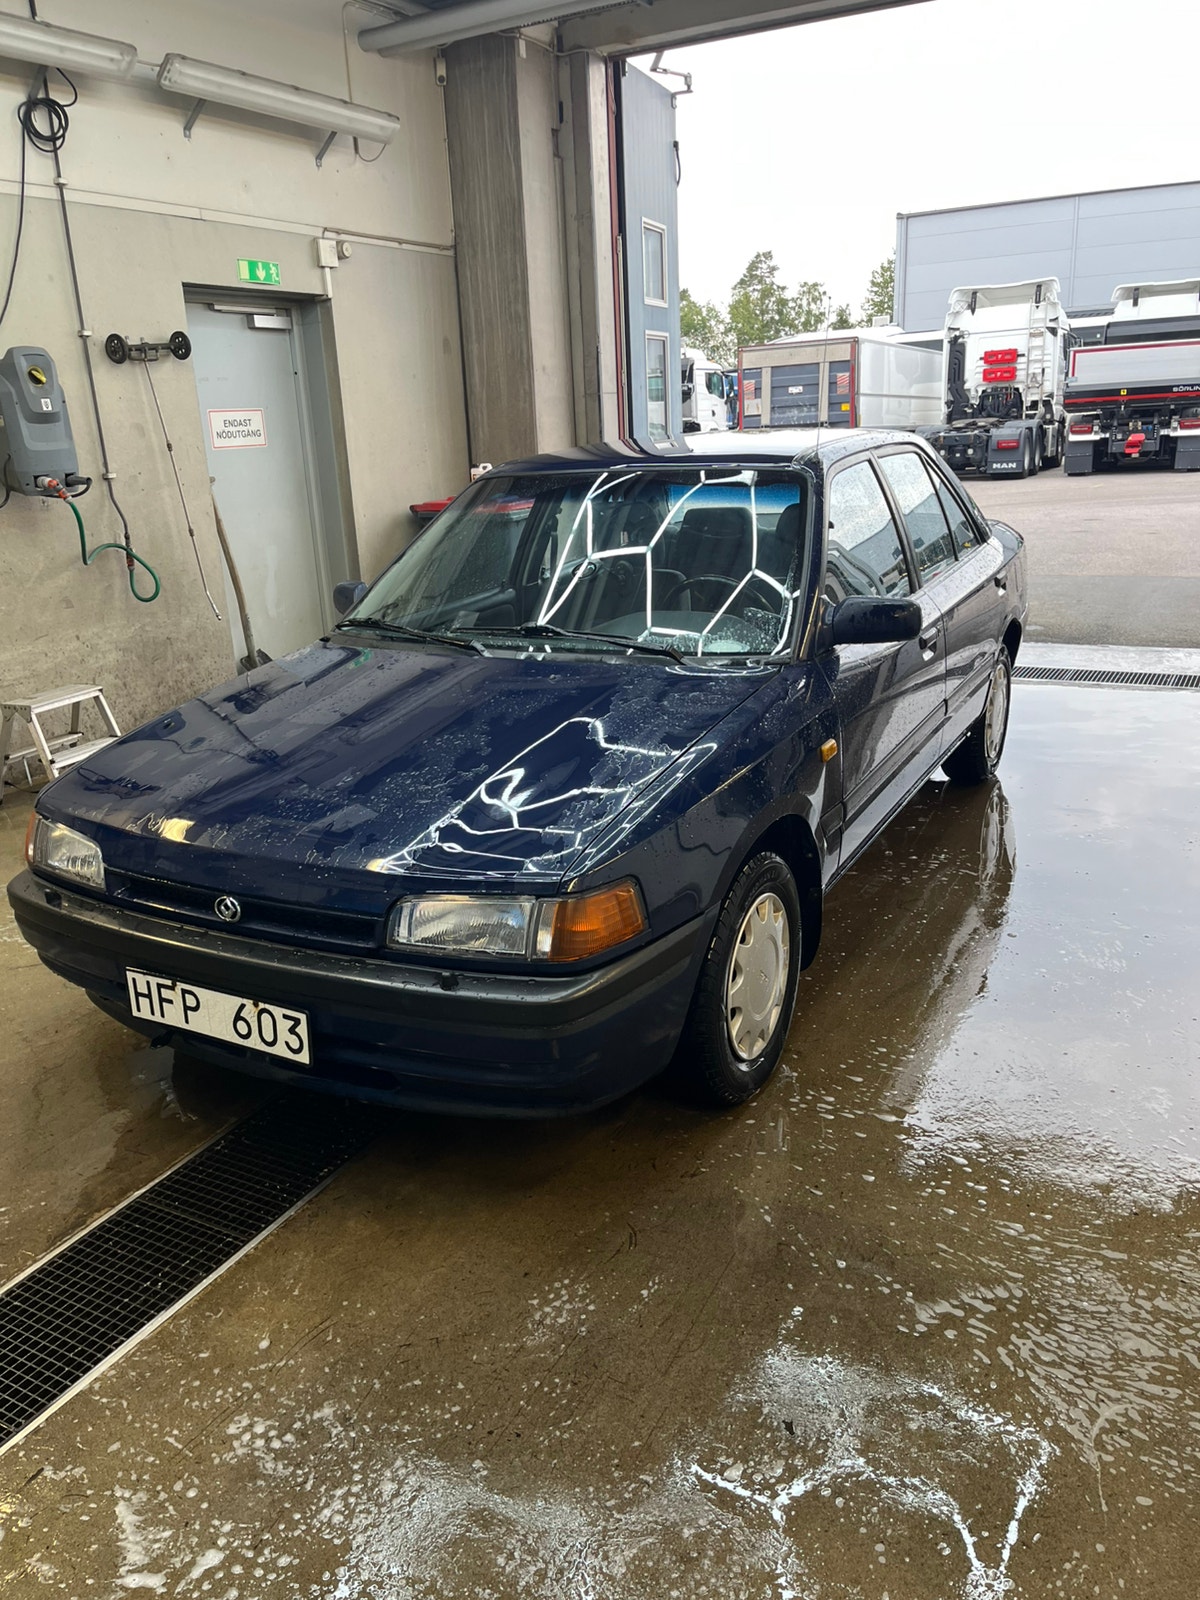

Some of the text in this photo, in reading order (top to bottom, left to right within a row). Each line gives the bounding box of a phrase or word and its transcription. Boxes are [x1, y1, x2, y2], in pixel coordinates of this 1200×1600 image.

[223, 418, 252, 428] ENDAST
[216, 429, 262, 439] NÖDUTGÅNG
[131, 976, 304, 1055] HFP 603
